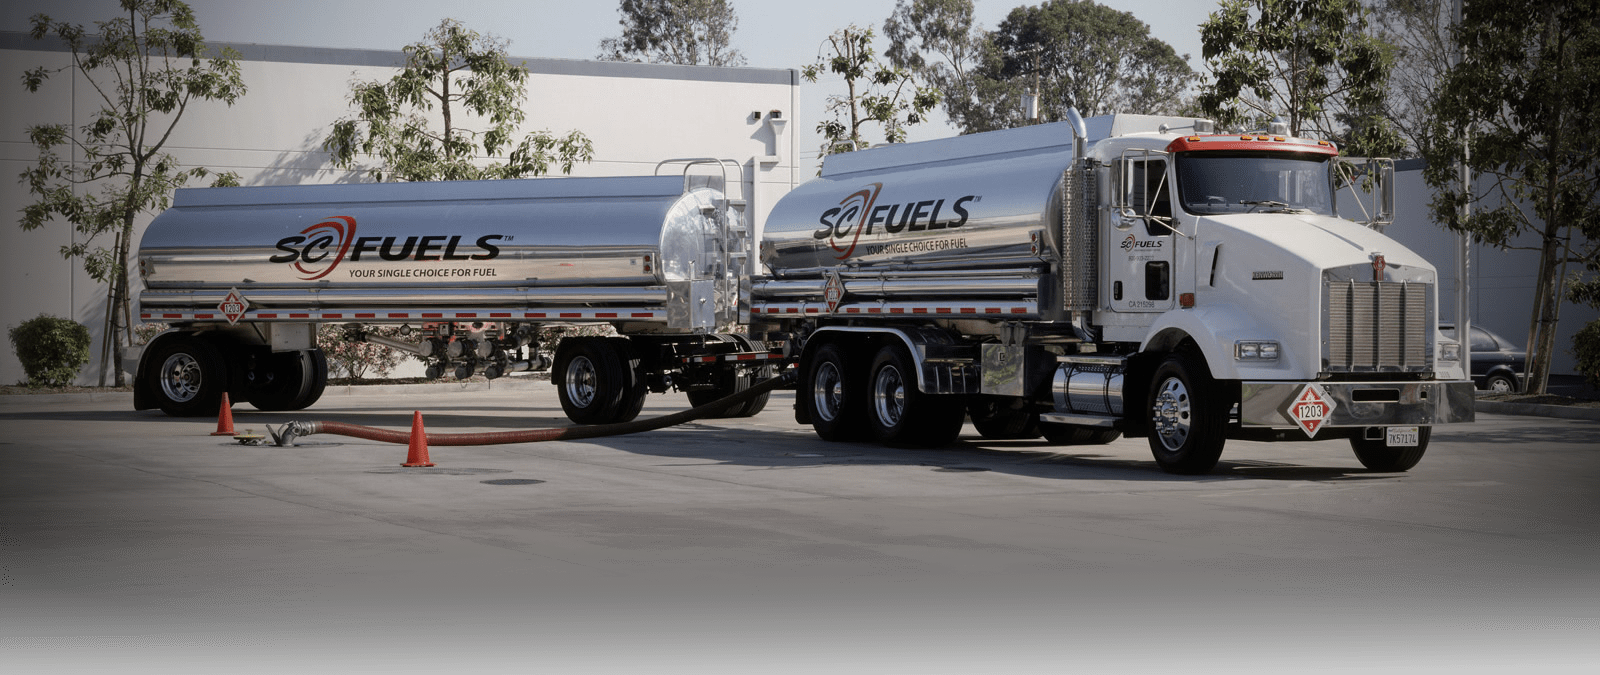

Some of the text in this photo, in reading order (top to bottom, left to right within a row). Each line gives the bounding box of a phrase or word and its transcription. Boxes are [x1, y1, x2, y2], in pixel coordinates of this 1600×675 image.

[813, 207, 860, 240] SC
[865, 195, 975, 236] FUELS
[269, 235, 334, 263] SC
[350, 234, 503, 261] FUELS
[866, 238, 968, 255] YOUR SINGLE CHOICE FOR FUEL
[349, 268, 497, 278] YOUR SINGLE CHOICE FOR FUEL
[225, 304, 240, 313] 1203
[1300, 405, 1322, 418] 1203
